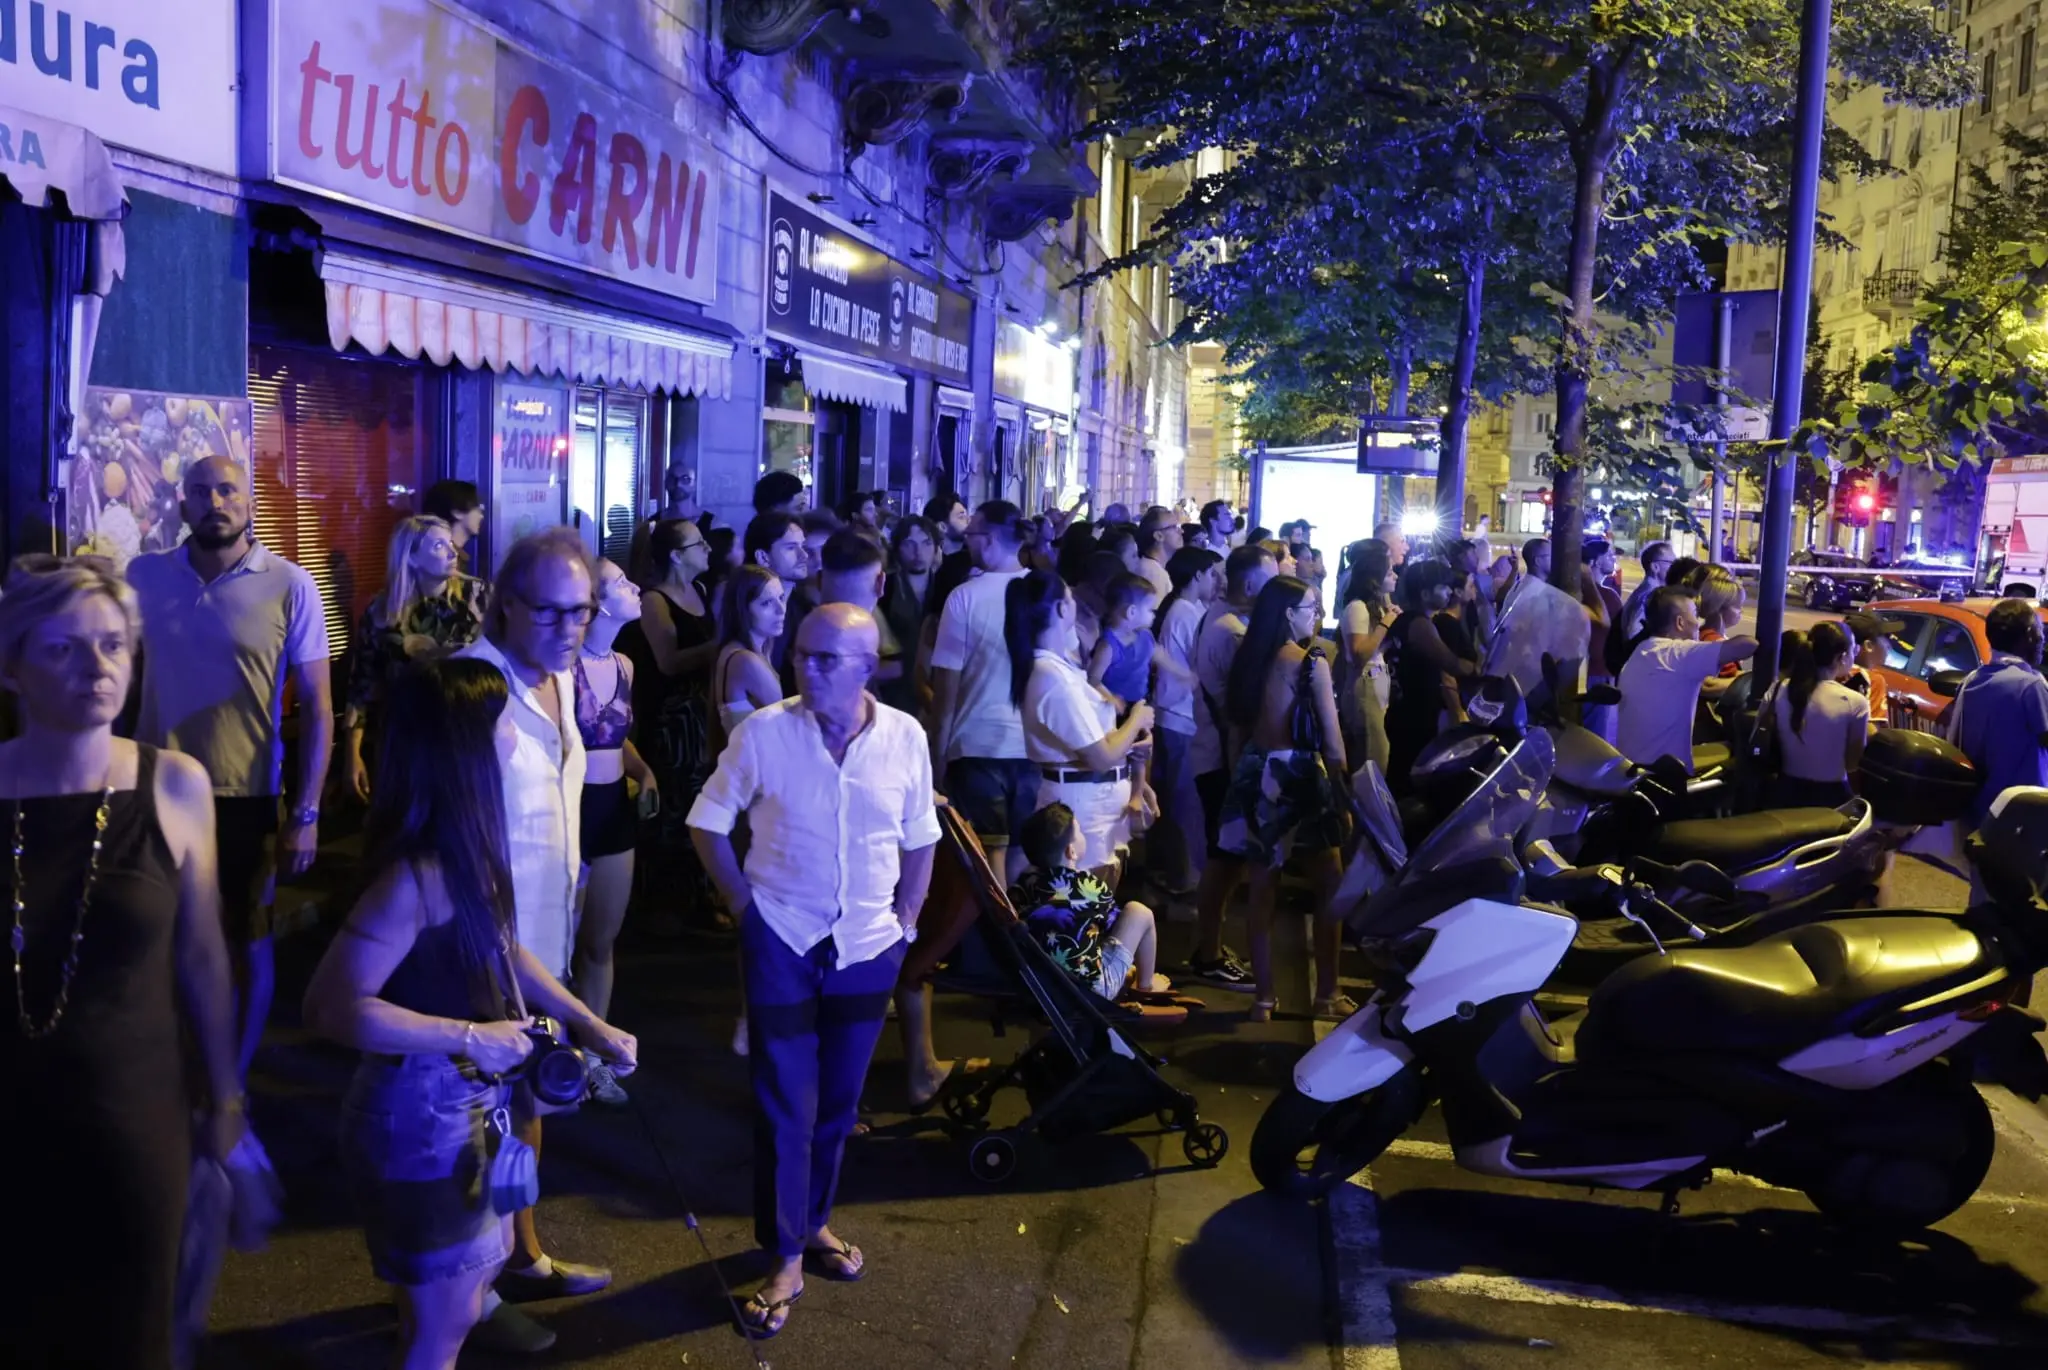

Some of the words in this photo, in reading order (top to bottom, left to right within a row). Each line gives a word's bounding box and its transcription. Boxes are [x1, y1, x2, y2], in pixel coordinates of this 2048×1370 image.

[299, 40, 470, 206] tutto
[502, 85, 707, 279] CARNI
[799, 227, 810, 271] AL
[809, 286, 821, 328] LA
[822, 291, 850, 337] CUCINA
[851, 303, 860, 340] DI
[861, 306, 881, 347] PESCE
